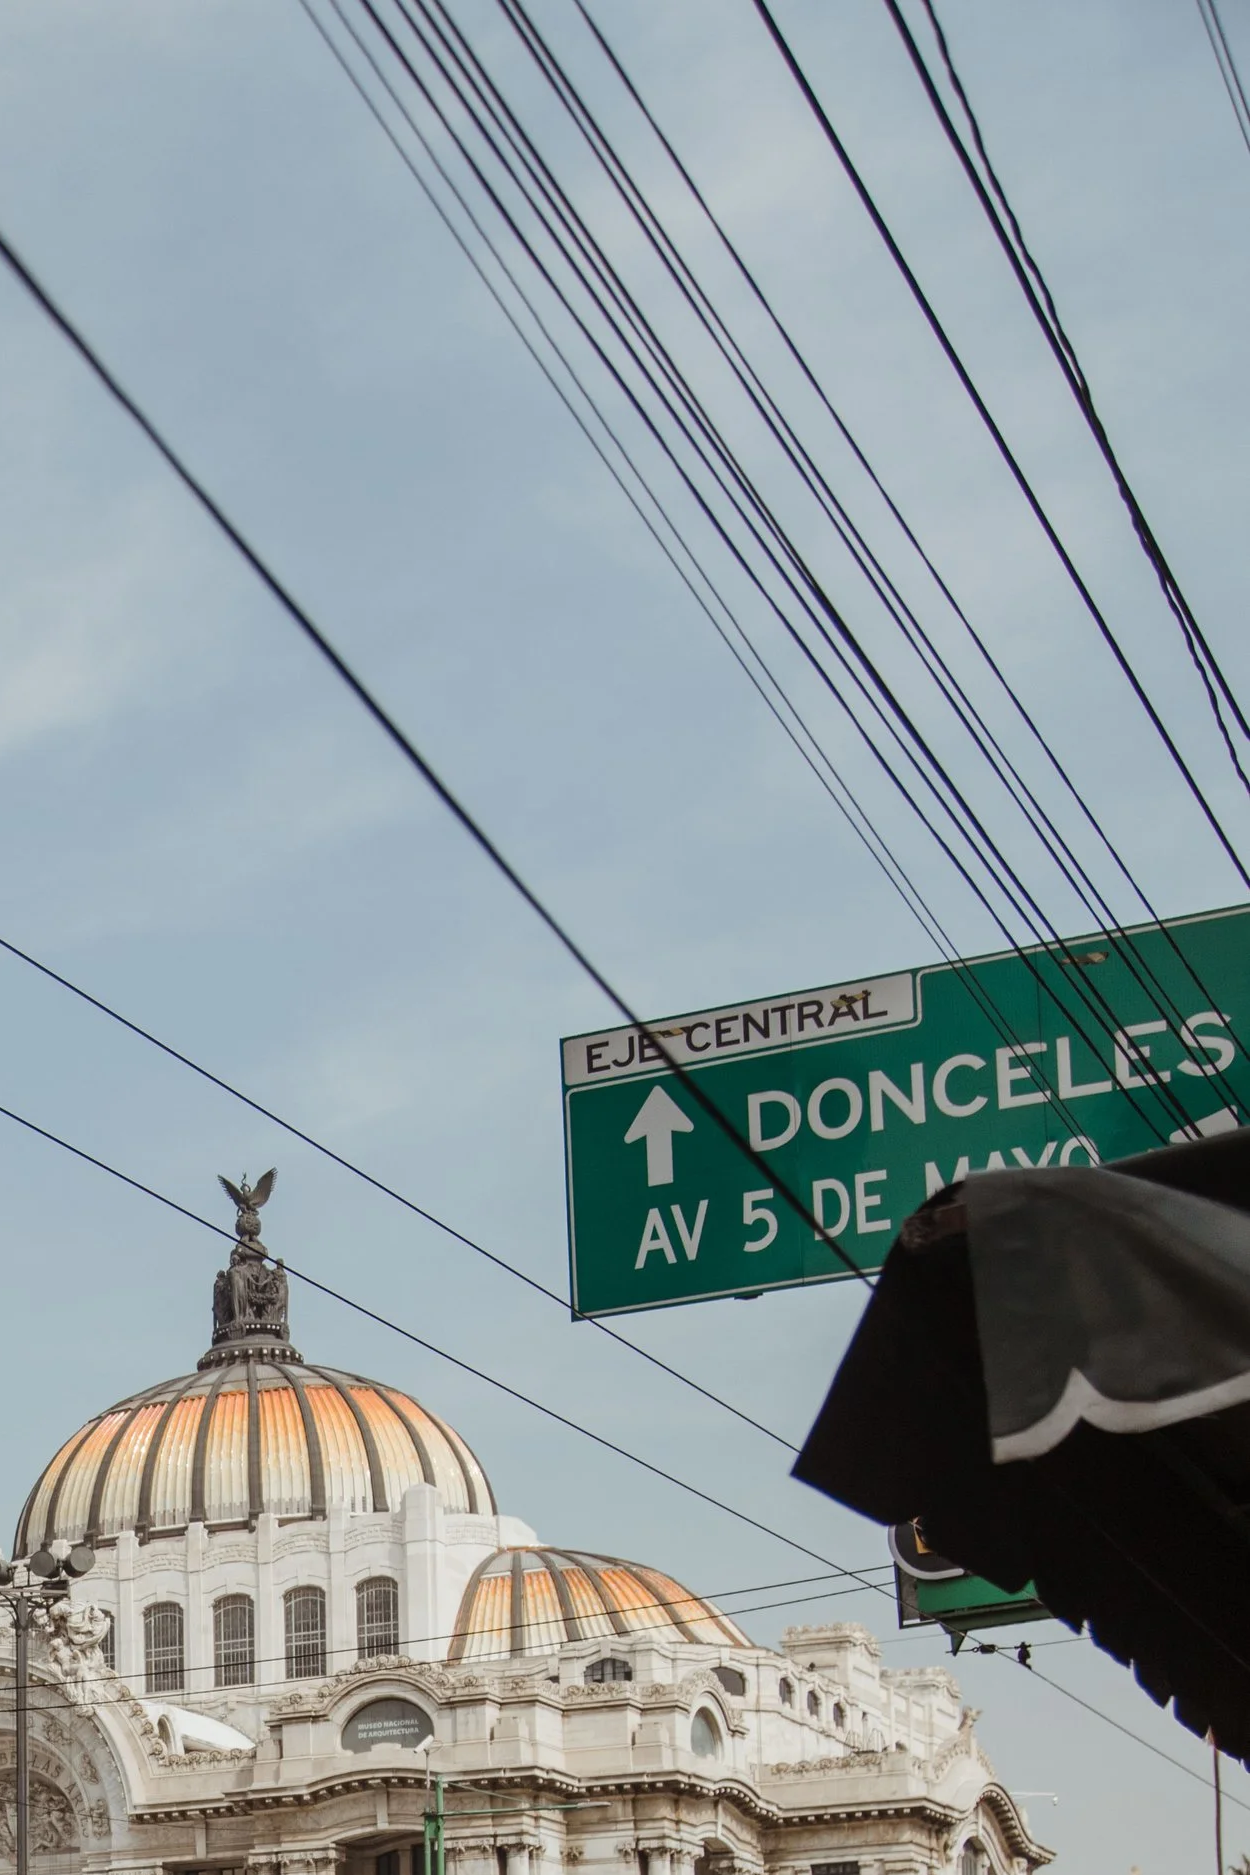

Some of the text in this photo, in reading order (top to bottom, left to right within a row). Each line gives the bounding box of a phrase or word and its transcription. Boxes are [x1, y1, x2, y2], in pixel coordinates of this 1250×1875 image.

[586, 988, 889, 1074] EJE CENTRAL
[747, 1010, 1237, 1153] DONCELES
[634, 1199, 709, 1270] AV
[742, 1187, 780, 1253] 5
[811, 1169, 892, 1241] DE
[357, 1719, 419, 1731] MUSEO NACIONAL
[368, 1727, 419, 1738] ARQUITECTURA
[0, 1751, 65, 1778] BELAS
[64, 1783, 90, 1839] ARTES
